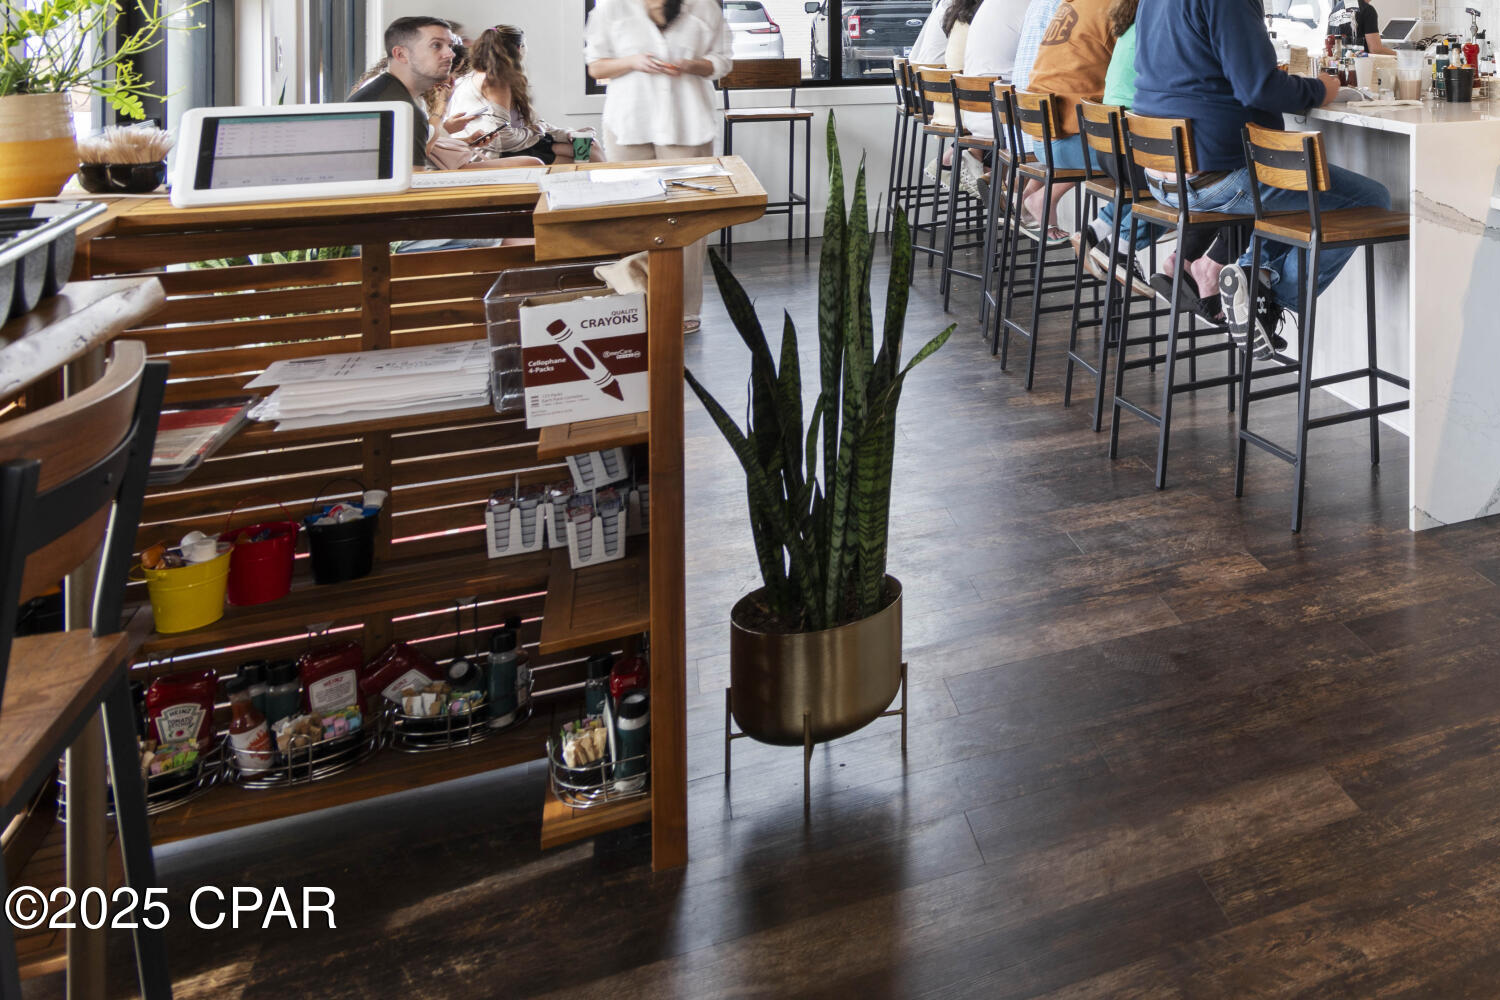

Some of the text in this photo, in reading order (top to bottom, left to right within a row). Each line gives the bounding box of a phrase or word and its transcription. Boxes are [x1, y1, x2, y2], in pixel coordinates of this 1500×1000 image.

[611, 308, 638, 316] QUALITY
[580, 313, 639, 329] CRAYONS
[527, 357, 567, 368] Cellophane
[528, 366, 555, 374] 4-Packs
